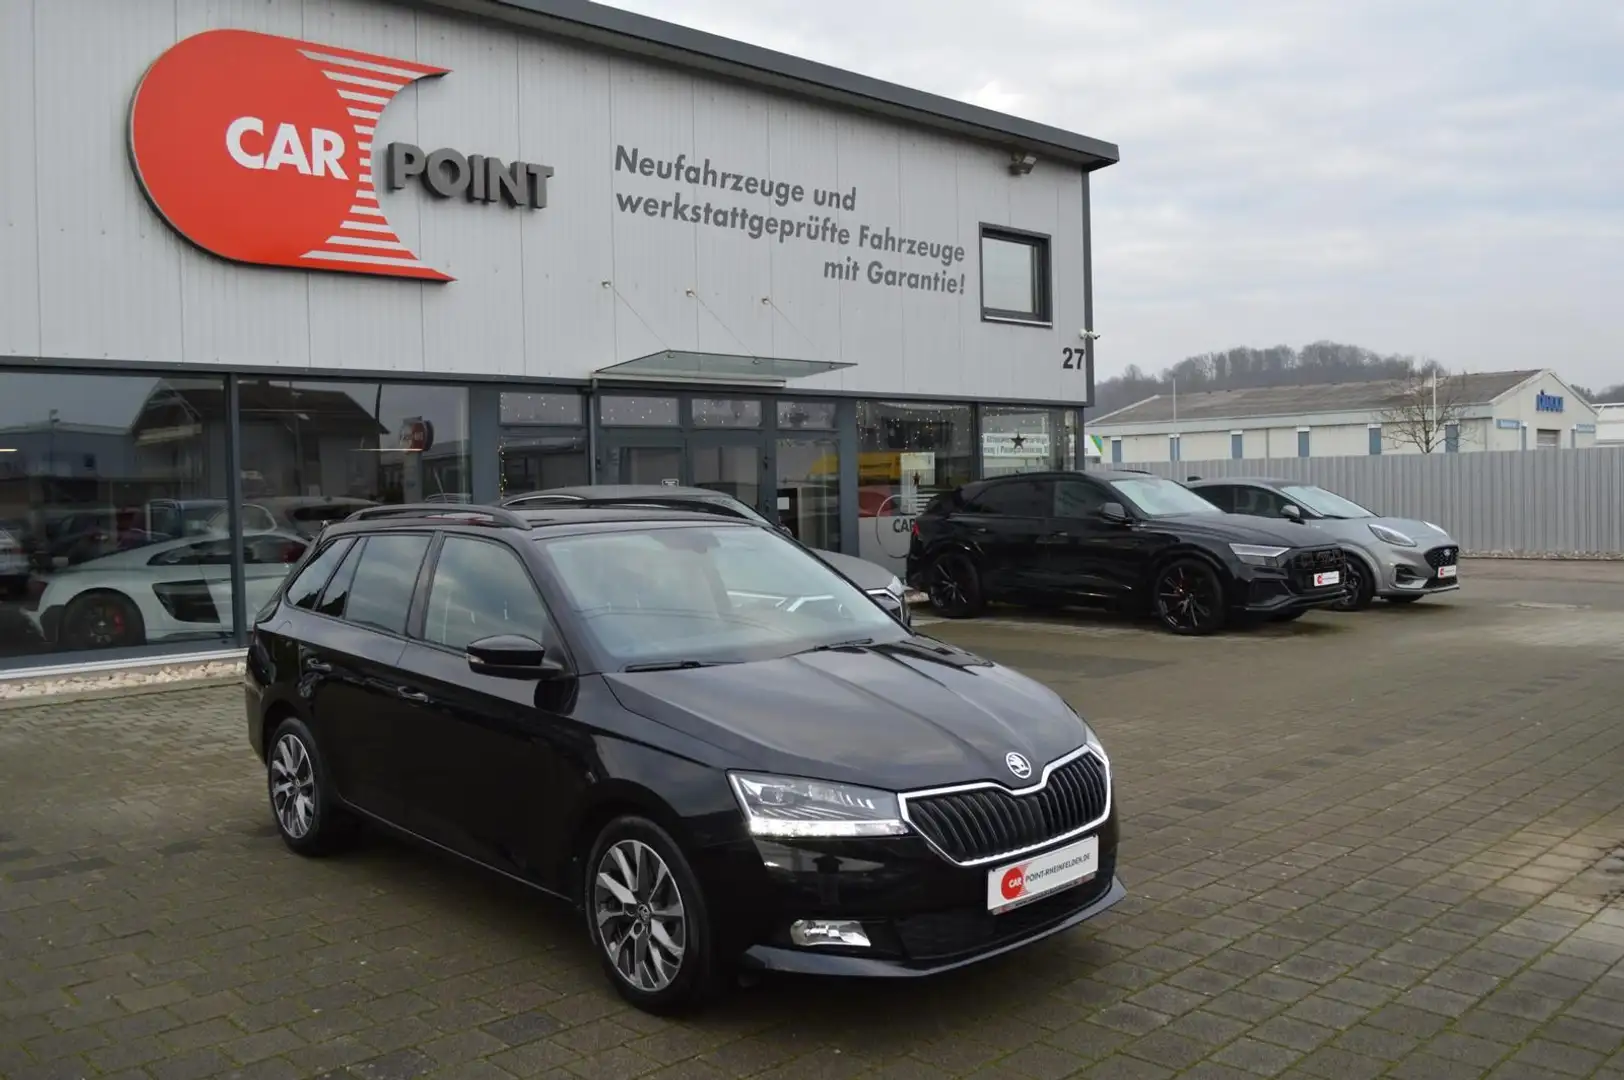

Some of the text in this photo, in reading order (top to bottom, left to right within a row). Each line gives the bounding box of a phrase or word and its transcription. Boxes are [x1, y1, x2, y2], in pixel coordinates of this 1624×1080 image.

[226, 116, 554, 209] CAR POINT
[615, 145, 857, 212] Neufahrzeuge und
[616, 192, 965, 267] werkstattgeprüfte Fahrzeuge
[823, 256, 966, 296] mit Garantie!
[1062, 347, 1085, 370] 27
[1008, 853, 1090, 888] CAR POINT-RHEINFELDEN.DE
